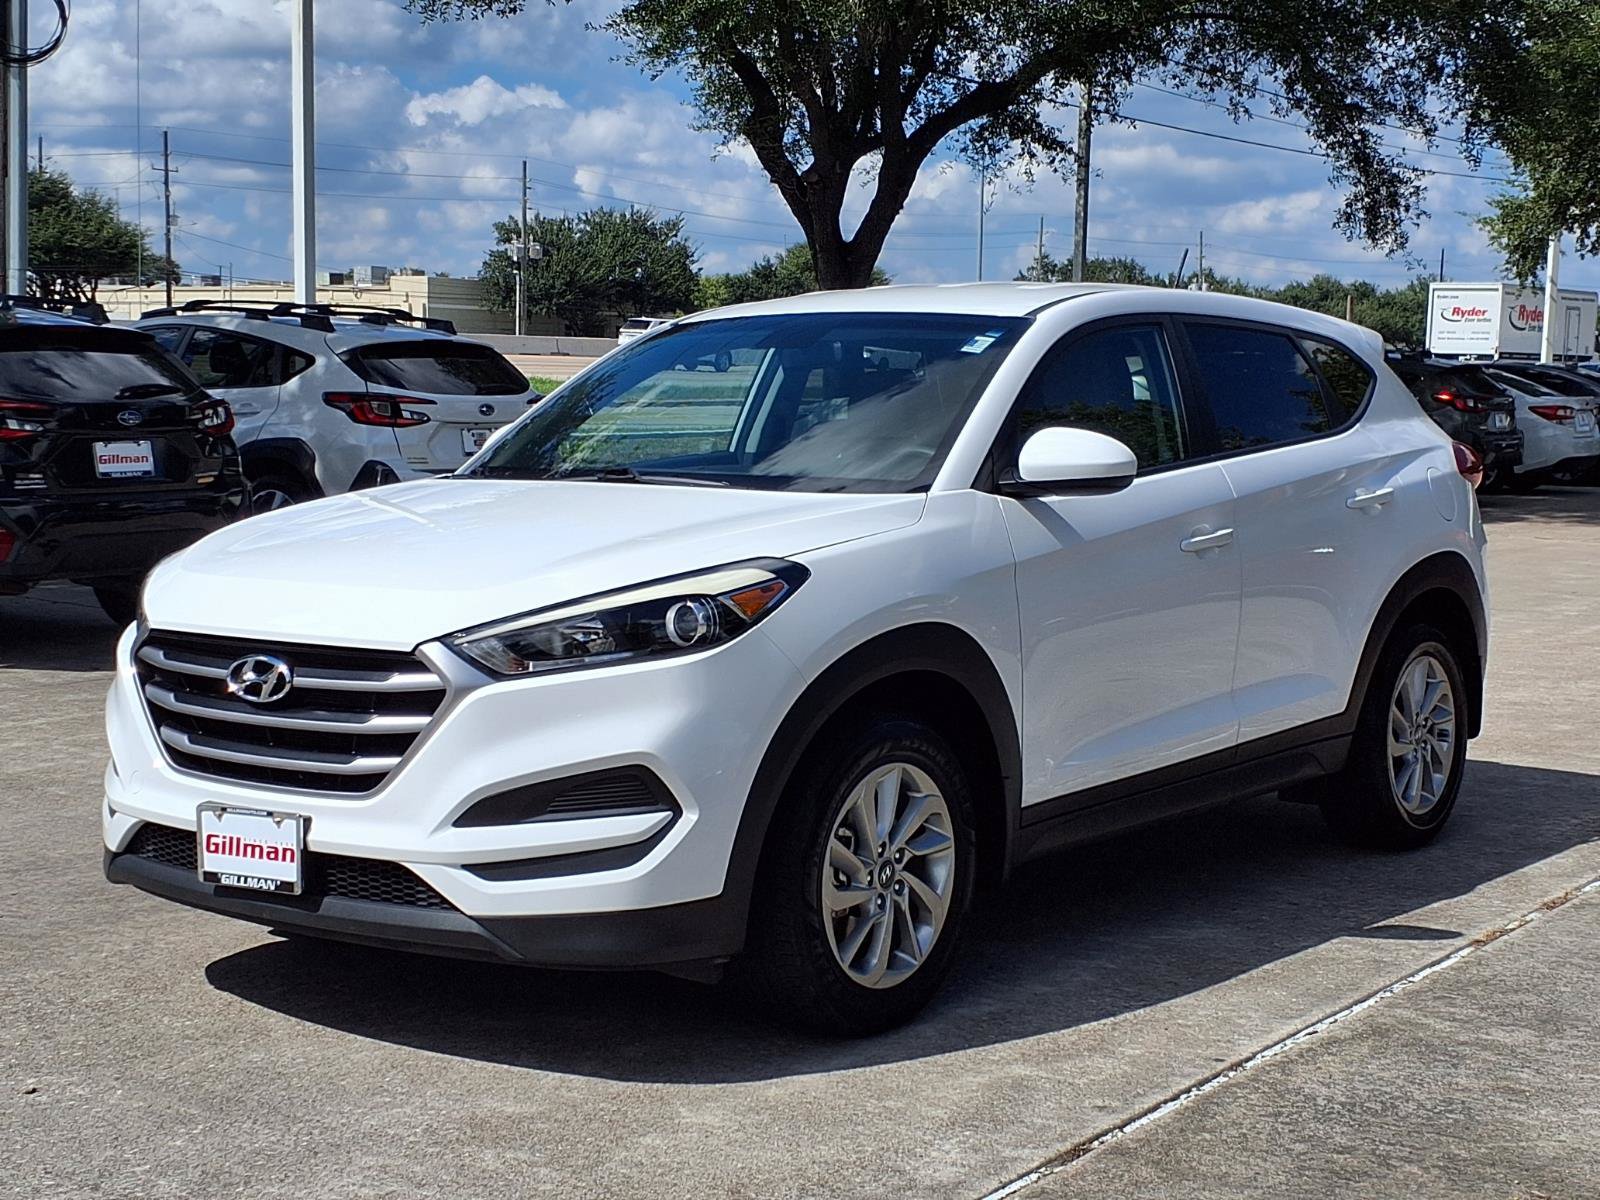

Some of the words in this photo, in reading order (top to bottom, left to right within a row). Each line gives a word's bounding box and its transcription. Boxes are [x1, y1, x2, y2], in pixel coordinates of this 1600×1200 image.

[1451, 306, 1488, 319] Ryder
[98, 454, 149, 465] Gillman
[205, 833, 295, 863] Gillman
